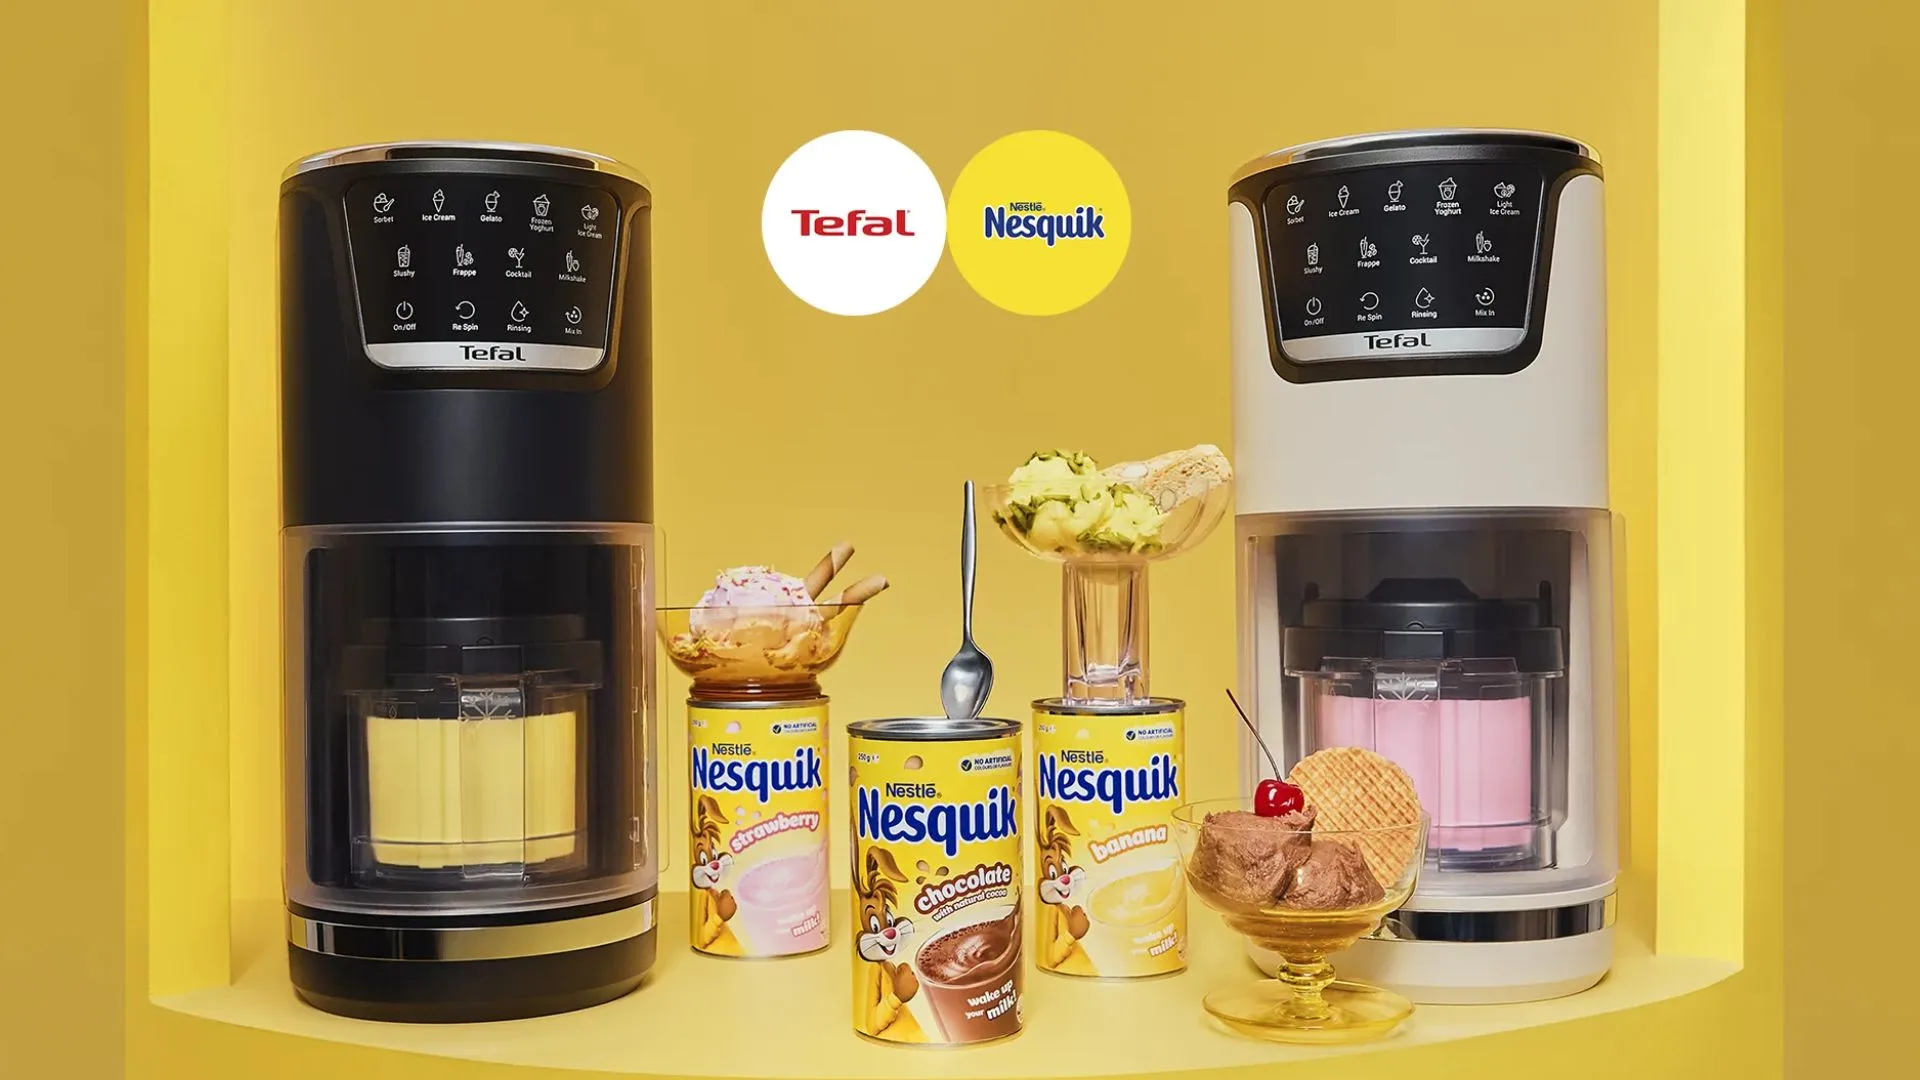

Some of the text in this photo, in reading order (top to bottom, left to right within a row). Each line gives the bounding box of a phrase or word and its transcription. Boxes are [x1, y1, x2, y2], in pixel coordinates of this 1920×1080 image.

[1340, 208, 1359, 216] Cream
[1384, 204, 1406, 212] Gelato
[1435, 208, 1461, 216] Yoghurt
[531, 217, 552, 225] Frozen
[1287, 216, 1304, 225] Sorbet
[529, 224, 554, 232] Yoghurt
[584, 223, 597, 231] Light
[588, 231, 602, 239] Cream
[1410, 256, 1437, 264] Cocktail
[1467, 255, 1500, 263] Milkshake
[1357, 260, 1380, 268] Frappe
[393, 269, 415, 277] Slushy
[453, 268, 476, 277] Frappe
[505, 271, 532, 279] Cocktail
[1304, 266, 1323, 275] Slushy
[559, 274, 586, 282] Milkshake
[1368, 313, 1382, 322] Spin
[1411, 310, 1437, 319] Rinsing
[1304, 317, 1324, 326] On/Off
[393, 323, 416, 331] On/Off
[463, 323, 478, 332] Spin
[507, 324, 532, 333] Rinsing
[1364, 333, 1431, 350] Tefal
[460, 346, 526, 361] Tefal
[985, 755, 1012, 764] ARTIFICIAL
[693, 747, 822, 803] Nesquik
[1040, 754, 1178, 814] Nesquik
[859, 786, 1017, 857] Nesquik
[732, 812, 819, 852] strawberry
[1091, 826, 1167, 862] banana
[917, 864, 1011, 912] chocolate
[933, 889, 1007, 922] with natural cocoa
[792, 911, 820, 937] milk!
[1149, 931, 1177, 956] milk!
[967, 979, 1014, 1007] wake up
[965, 989, 1017, 1020] your milk!
